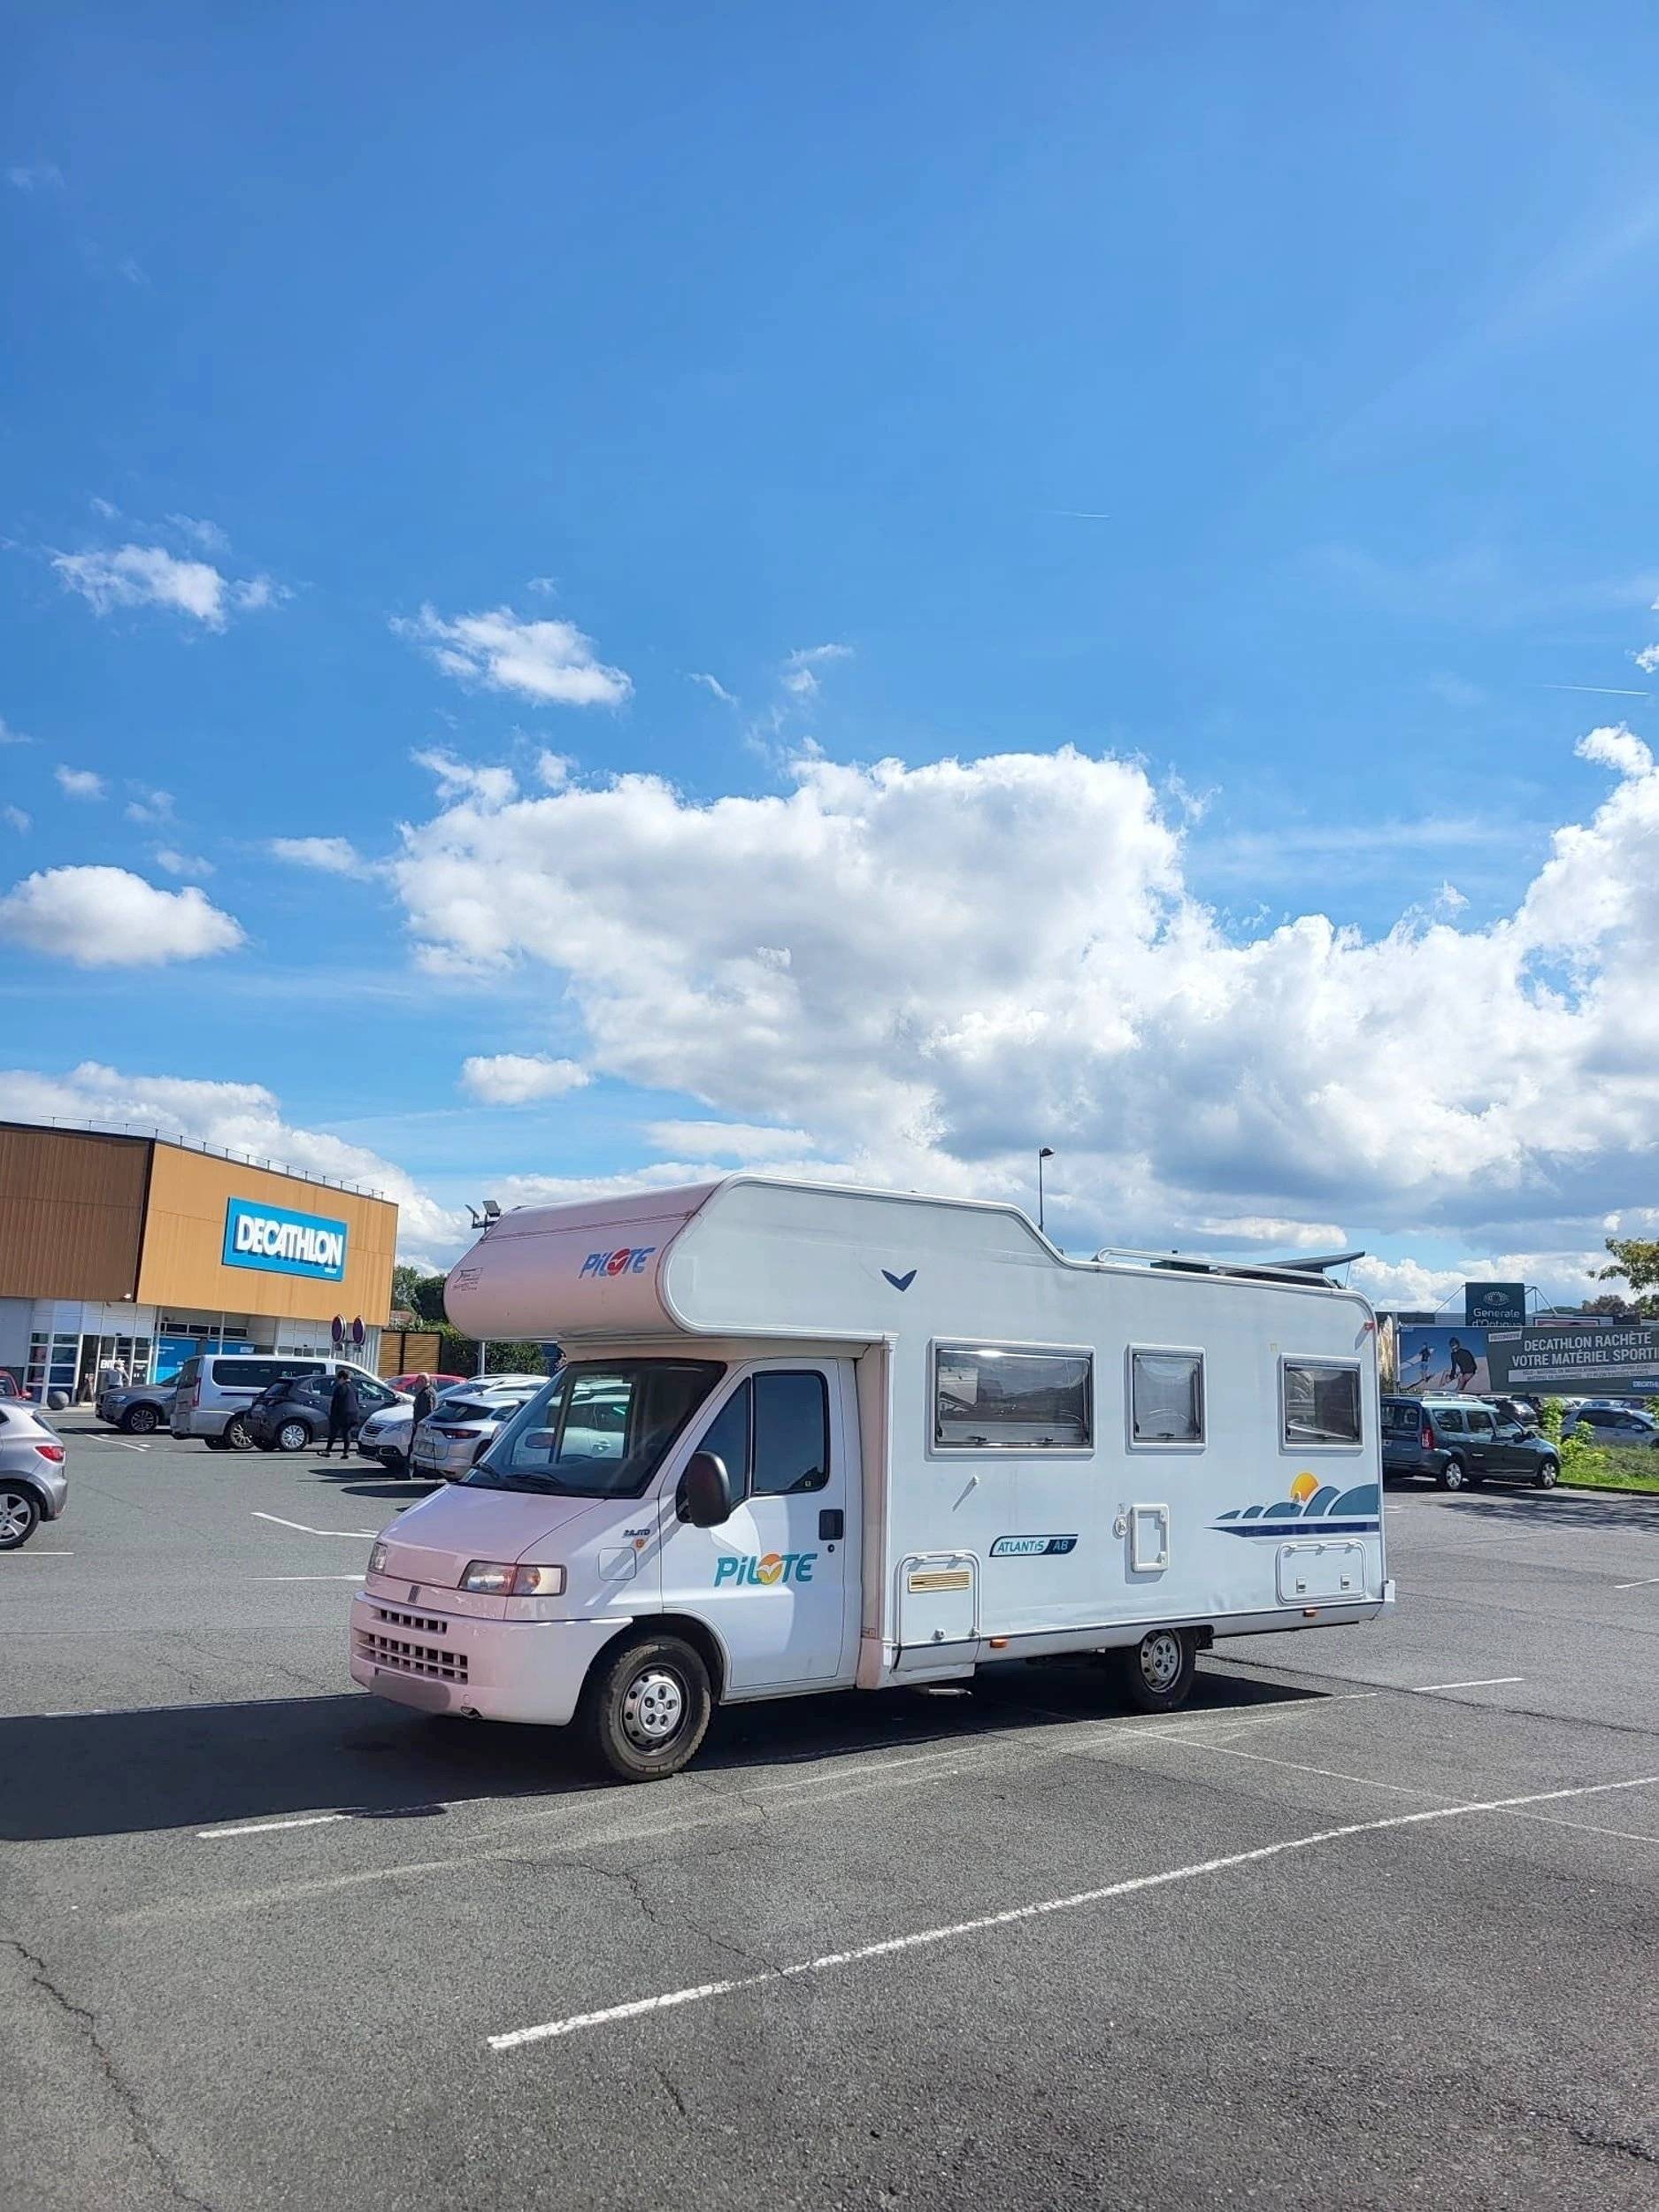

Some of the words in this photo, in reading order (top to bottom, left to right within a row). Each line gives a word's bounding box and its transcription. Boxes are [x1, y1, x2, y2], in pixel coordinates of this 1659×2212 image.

[234, 1213, 343, 1266] DECATHLON
[1524, 1336, 1593, 1352] DECATHLON
[1594, 1330, 1653, 1348] RACHÈTE
[1512, 1353, 1549, 1367] VOTRE
[1551, 1349, 1609, 1365] MATÉRIEL
